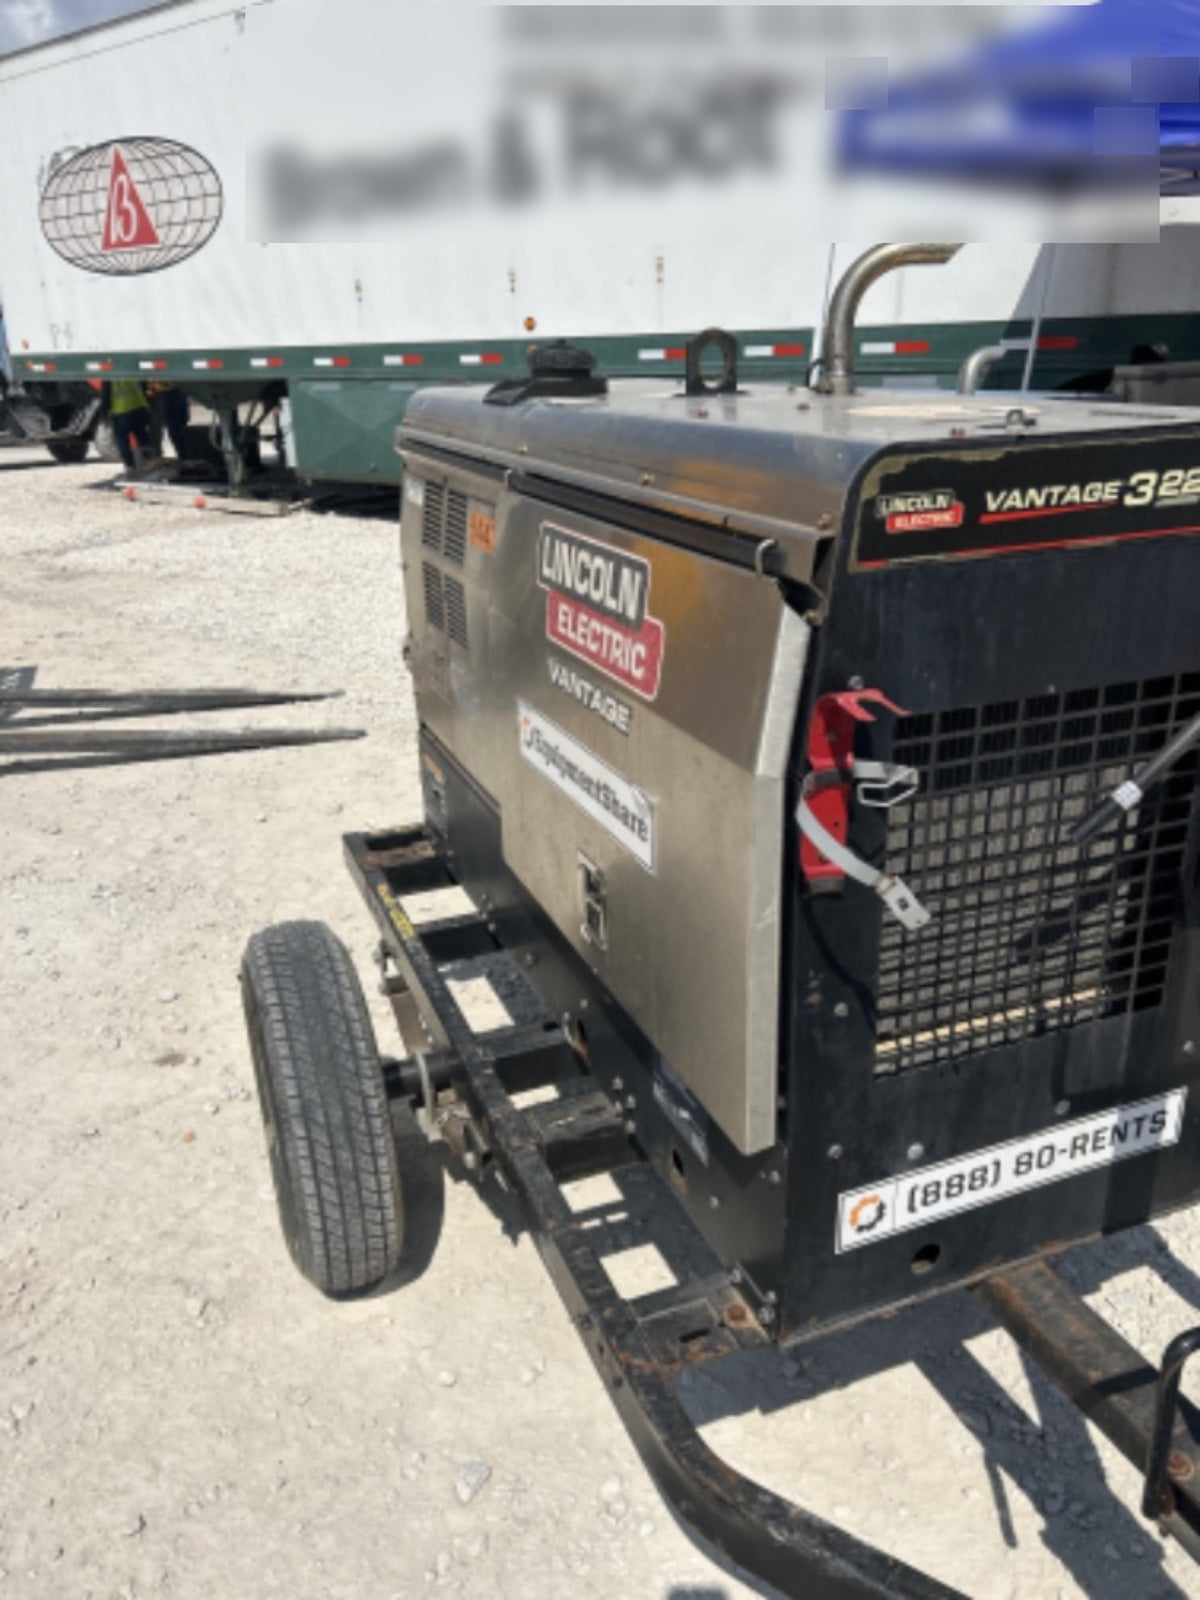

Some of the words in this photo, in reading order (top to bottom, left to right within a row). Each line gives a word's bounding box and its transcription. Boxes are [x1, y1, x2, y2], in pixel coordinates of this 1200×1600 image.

[880, 493, 951, 514] LINCOLN
[986, 481, 1122, 512] VANTAGE
[541, 534, 643, 622] LINCOLN
[556, 602, 647, 679] ELECTRIC
[548, 655, 633, 734] VANTAGE
[907, 1161, 1001, 1214] (888)
[1012, 1109, 1168, 1177] 80-RENTS
